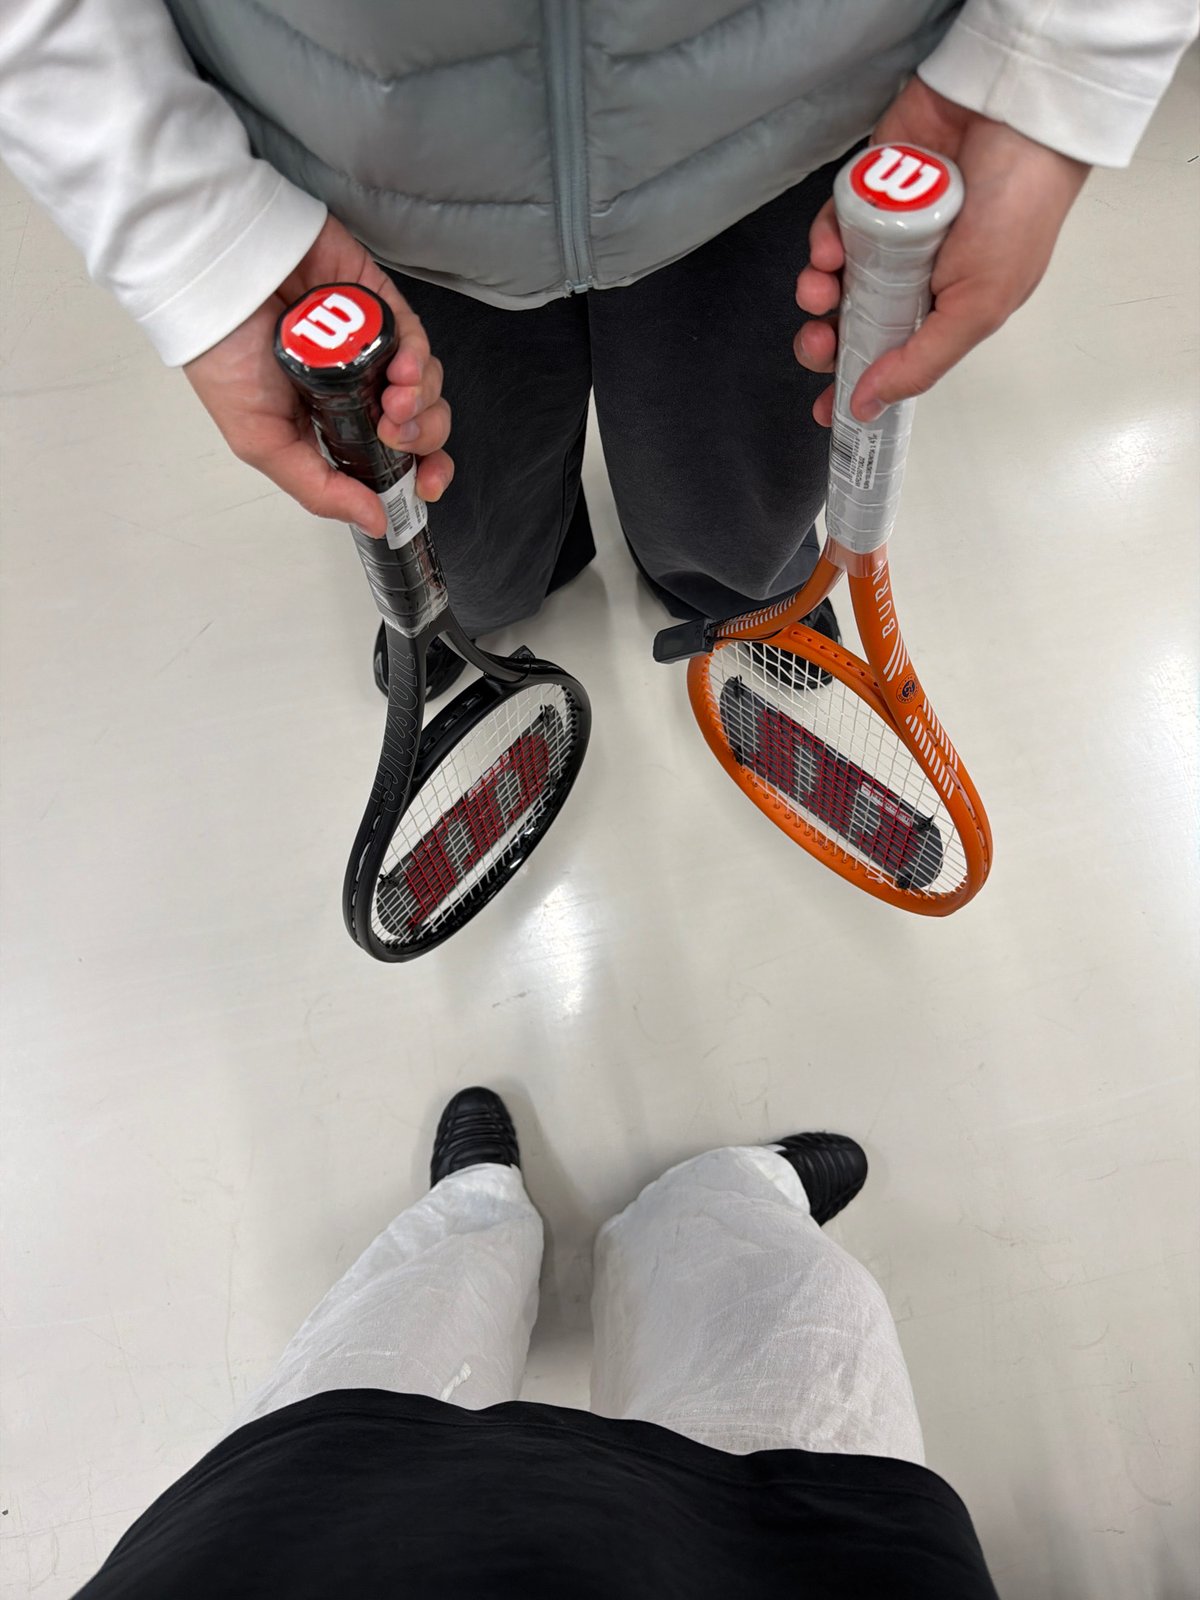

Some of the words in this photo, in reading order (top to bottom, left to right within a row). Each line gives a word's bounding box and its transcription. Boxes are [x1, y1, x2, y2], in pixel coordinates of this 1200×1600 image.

[864, 148, 941, 201] W
[292, 293, 366, 349] W
[873, 559, 896, 639] BURN
